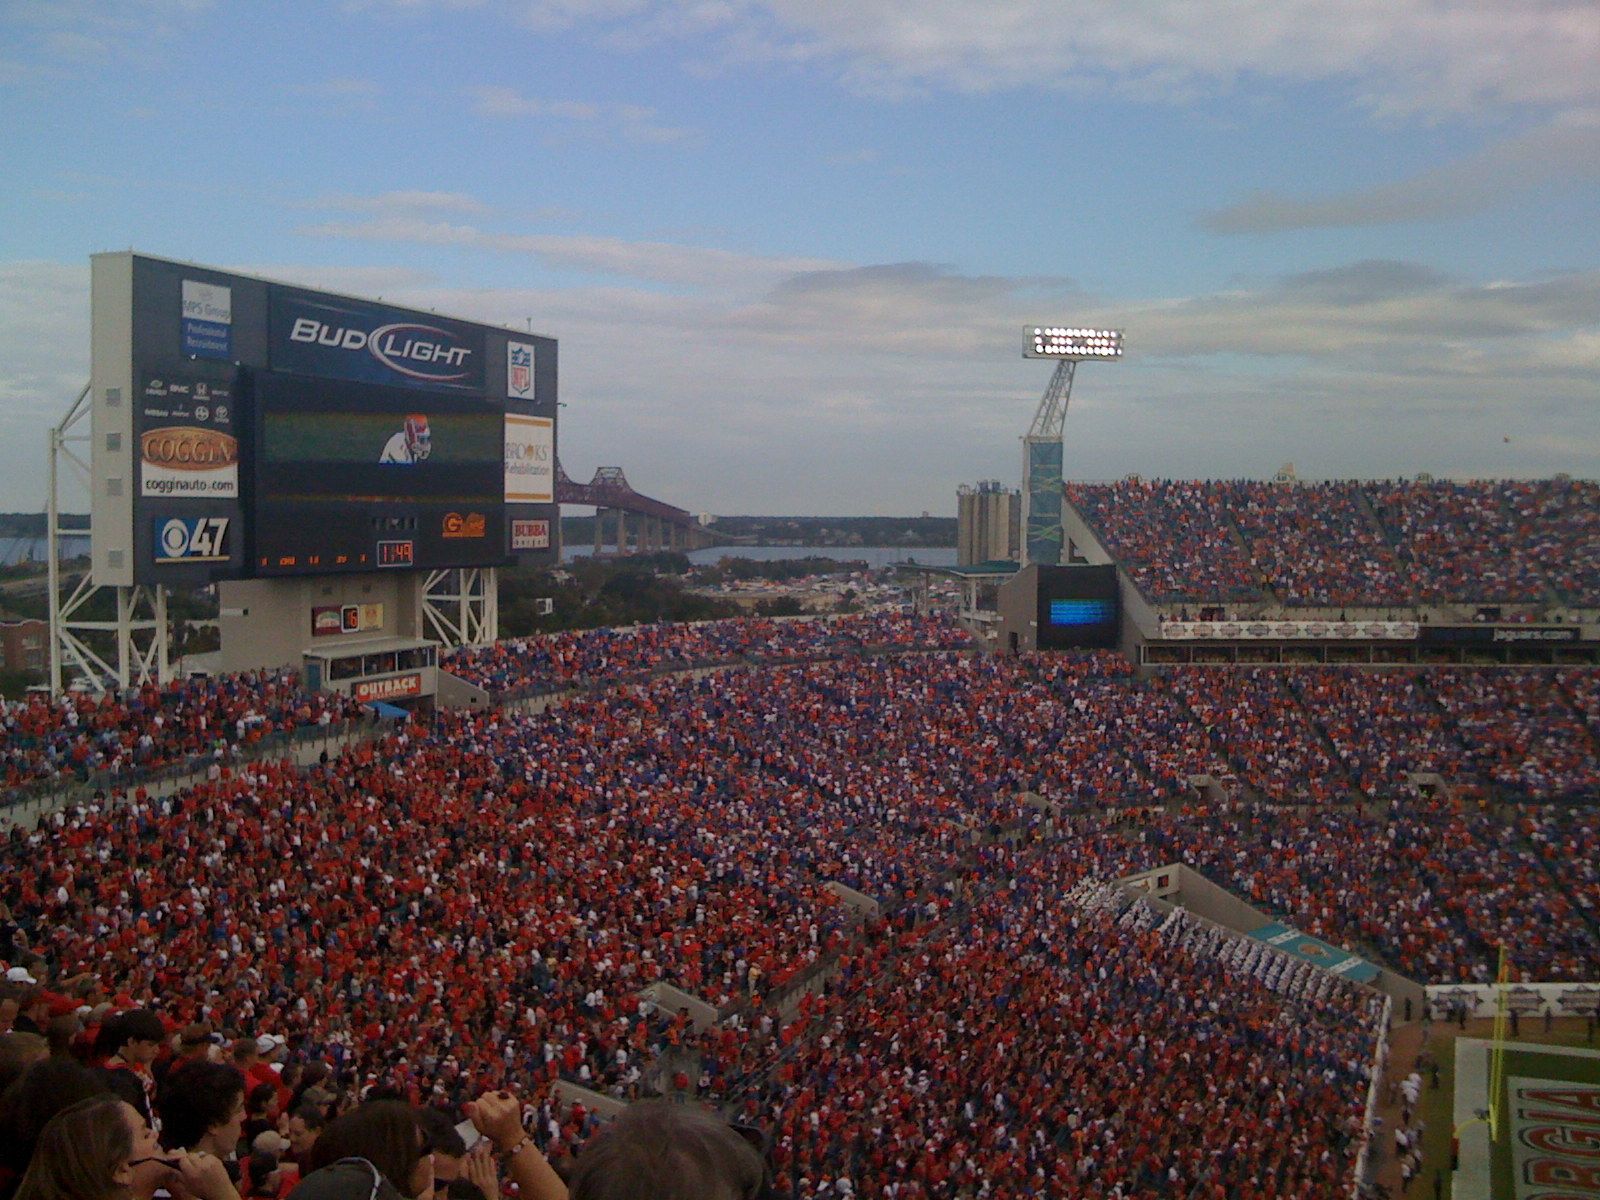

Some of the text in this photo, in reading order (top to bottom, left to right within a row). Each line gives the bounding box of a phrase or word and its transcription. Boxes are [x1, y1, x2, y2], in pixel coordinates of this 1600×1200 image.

[290, 318, 471, 366] BUD LIGHT
[146, 477, 233, 492] cogginauto.com
[190, 518, 230, 557] 47
[359, 676, 416, 696] OUTBACK
